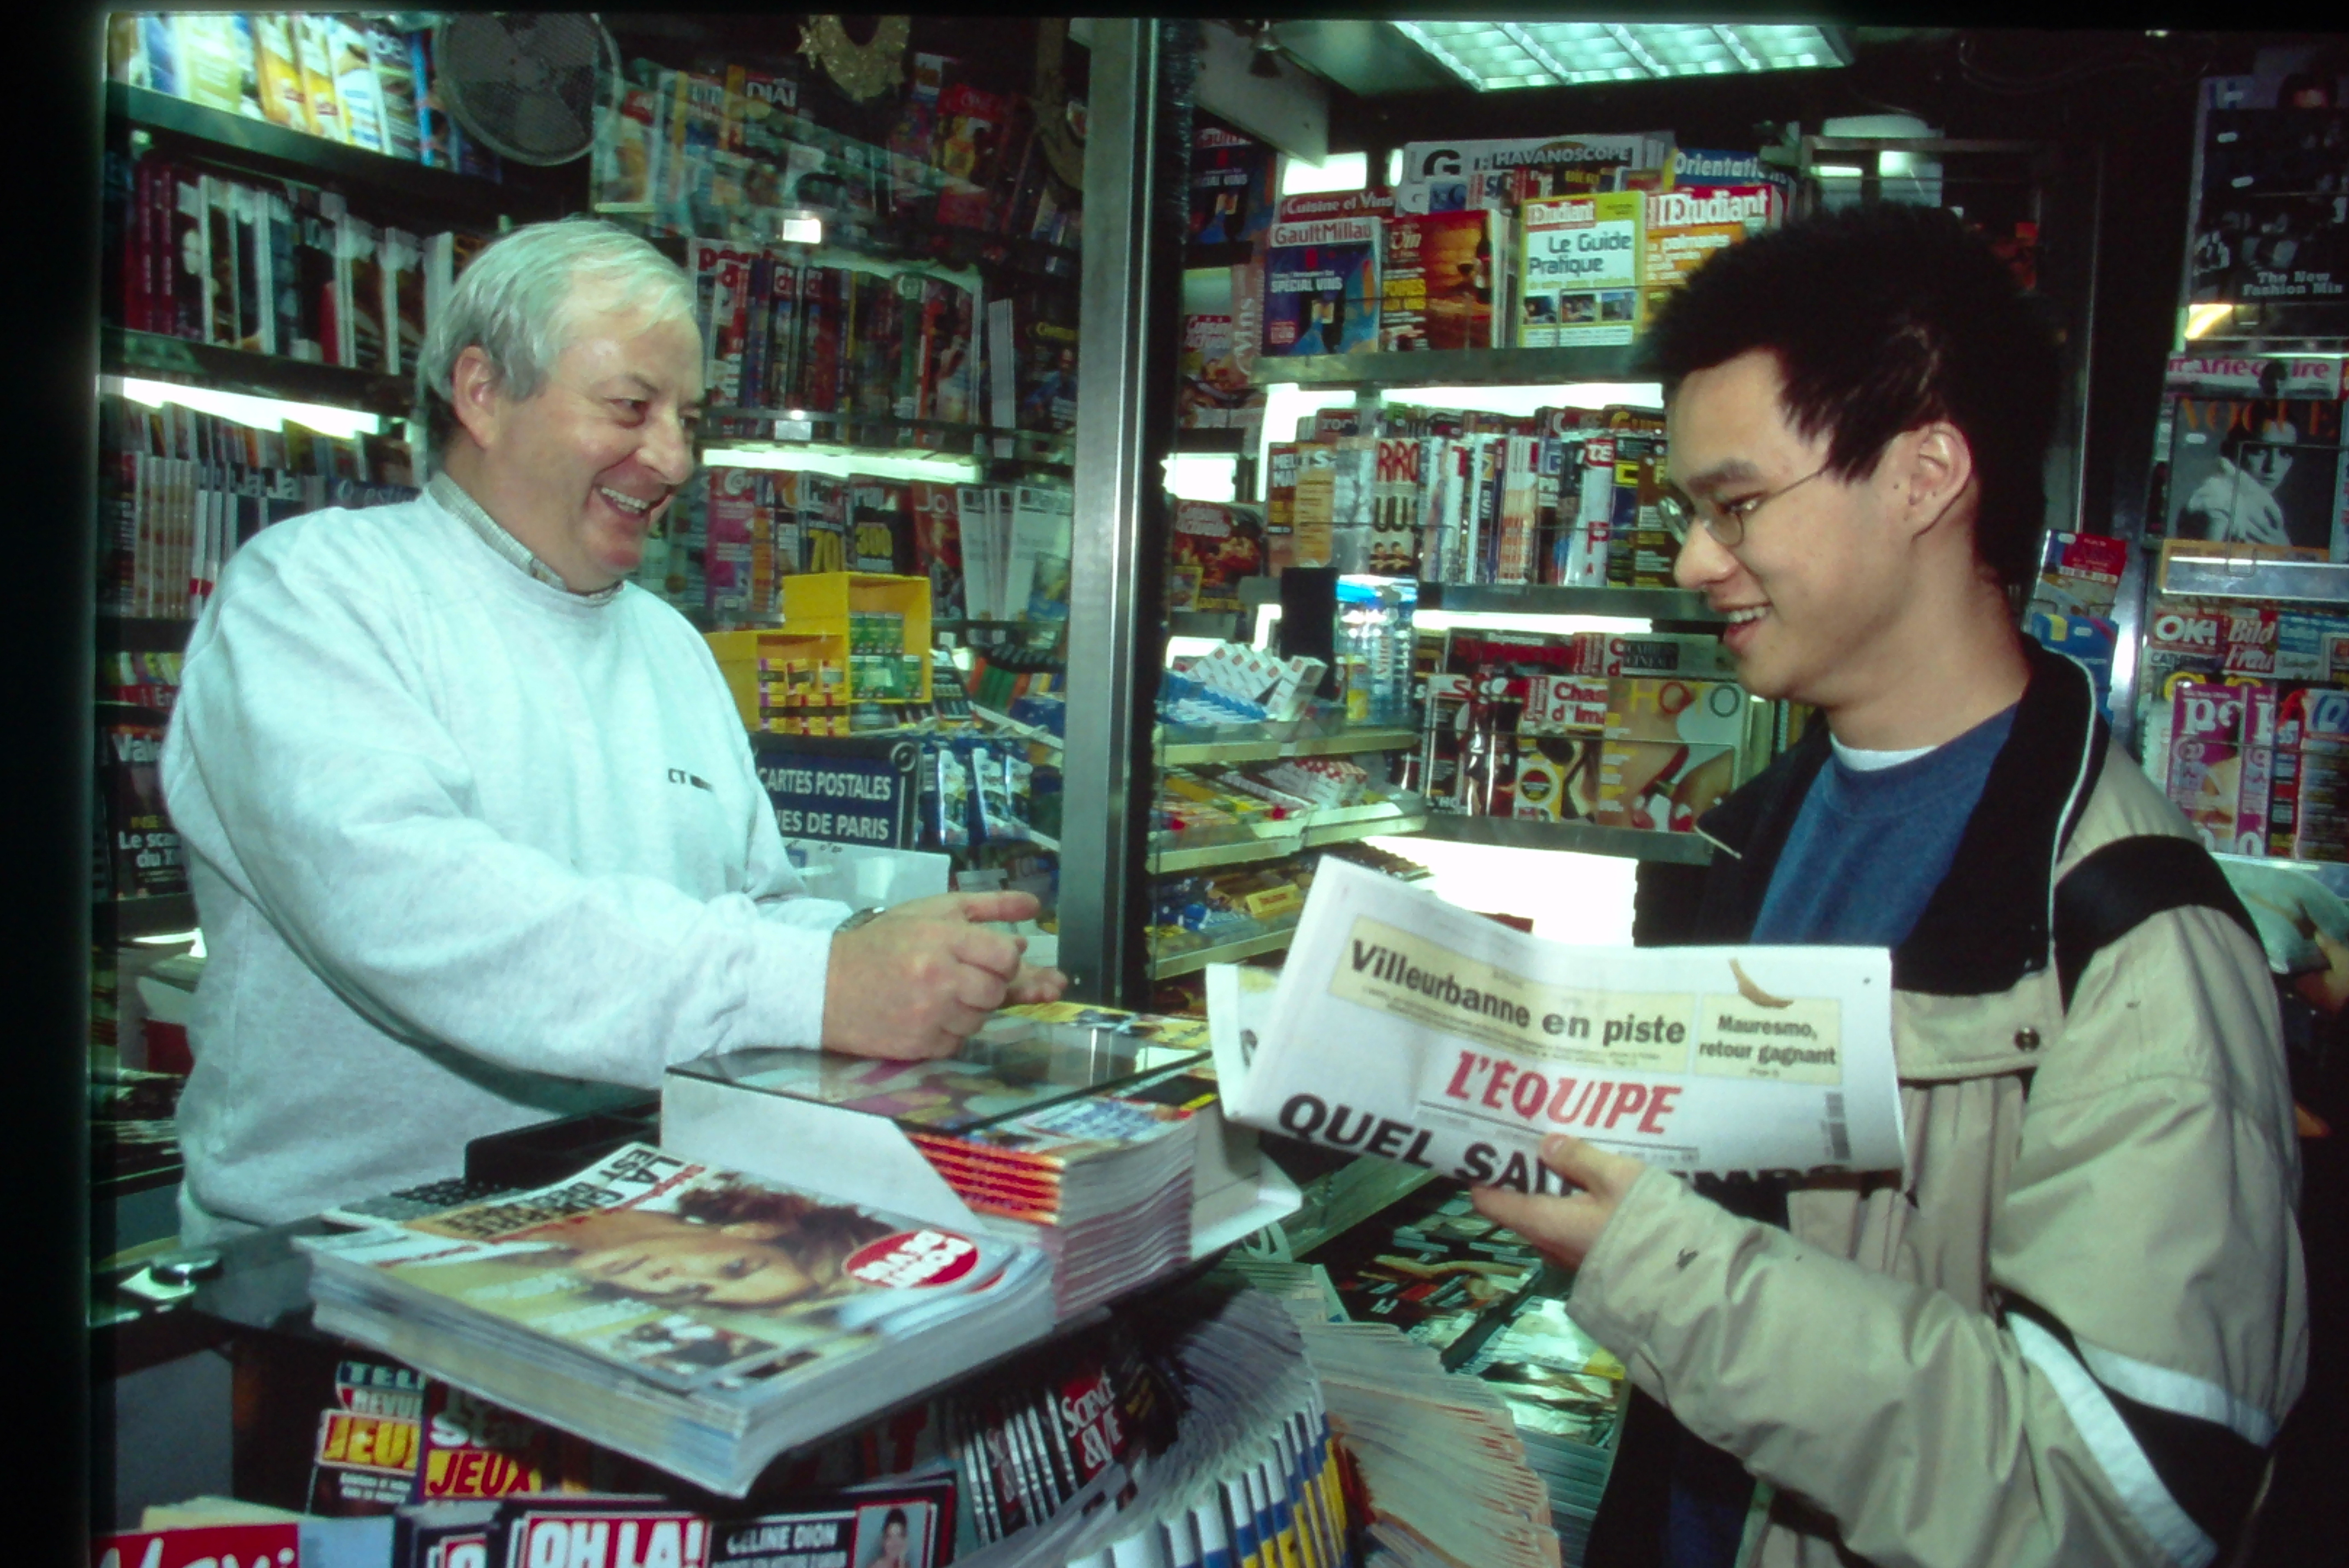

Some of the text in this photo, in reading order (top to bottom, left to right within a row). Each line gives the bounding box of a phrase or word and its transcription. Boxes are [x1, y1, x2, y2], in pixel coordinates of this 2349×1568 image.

[1275, 221, 1372, 244] GaultMillau
[1549, 231, 1632, 253] Le Guide
[1528, 254, 1604, 278] Pratique
[854, 525, 893, 557] 300
[2154, 615, 2217, 646] OK!
[2228, 618, 2276, 644] Bild
[758, 767, 892, 801] CARTES POSTALES
[806, 811, 832, 835] DE
[837, 814, 889, 841] PARIS
[1350, 938, 1531, 1029] Villeurbanne
[1542, 1011, 1590, 1039] en
[1603, 1013, 1686, 1047] piste
[1718, 1014, 1818, 1041] Mauresmo,
[1699, 1040, 1836, 1067] retour gagnant
[1278, 1093, 1436, 1170] QUEL
